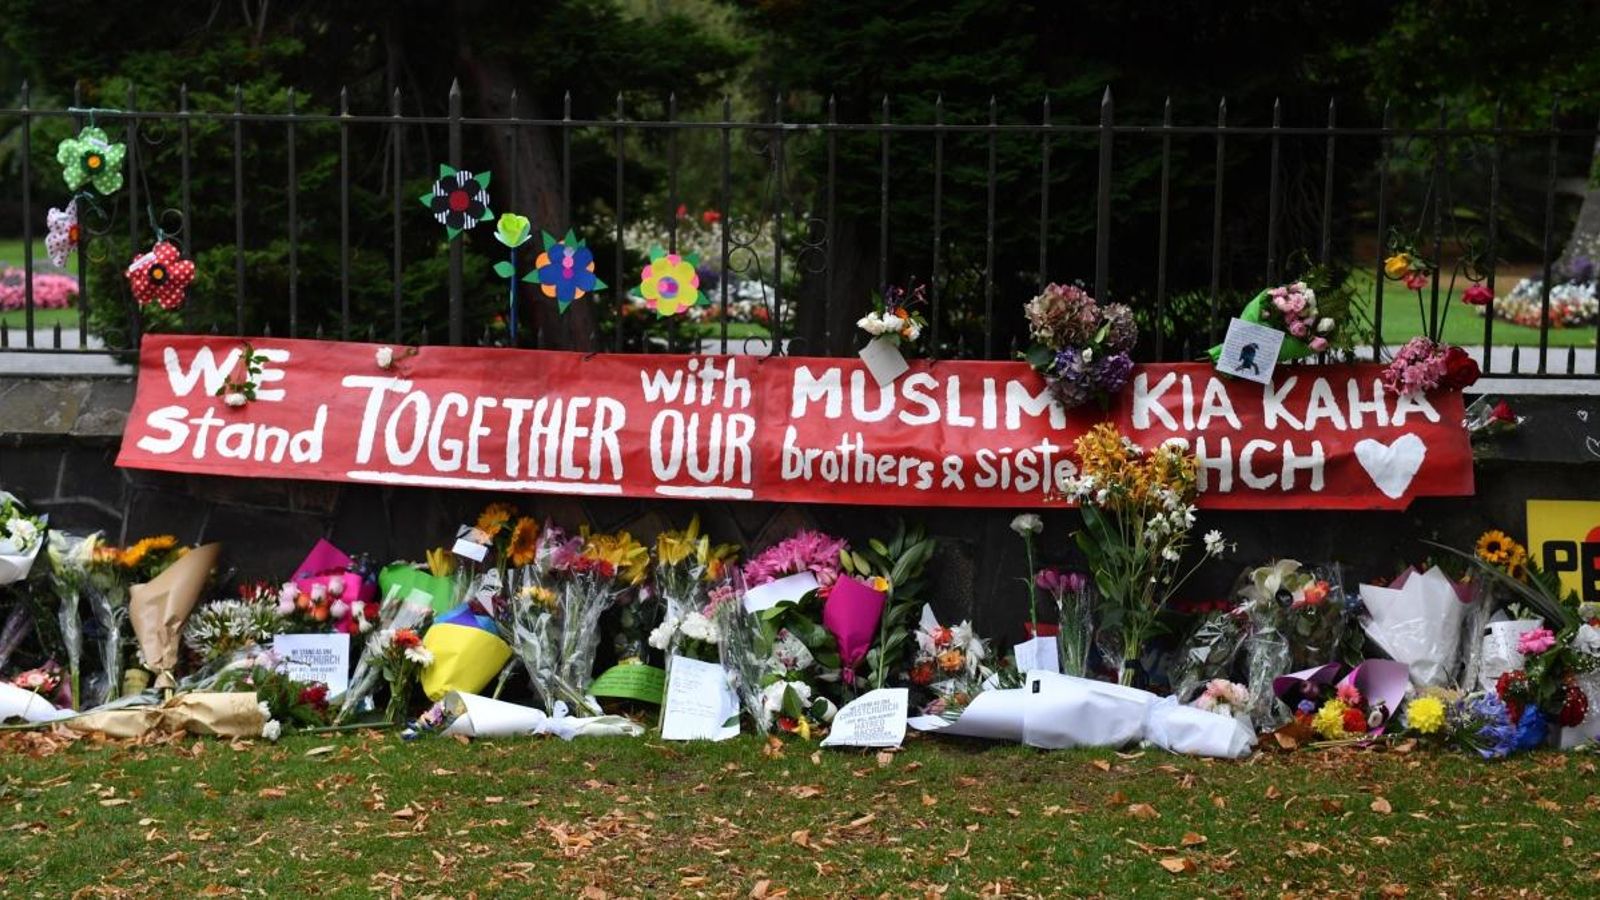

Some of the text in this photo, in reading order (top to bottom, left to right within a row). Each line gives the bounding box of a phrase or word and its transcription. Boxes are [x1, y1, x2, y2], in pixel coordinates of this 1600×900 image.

[164, 346, 291, 401] WE
[640, 357, 752, 410] with
[790, 365, 1066, 432] MUSLIM
[1131, 371, 1441, 432] KIA KAHA
[136, 374, 627, 481] Stand TOGETHER
[649, 409, 757, 485] OUR
[781, 424, 935, 491] brothers
[941, 453, 966, 491] &
